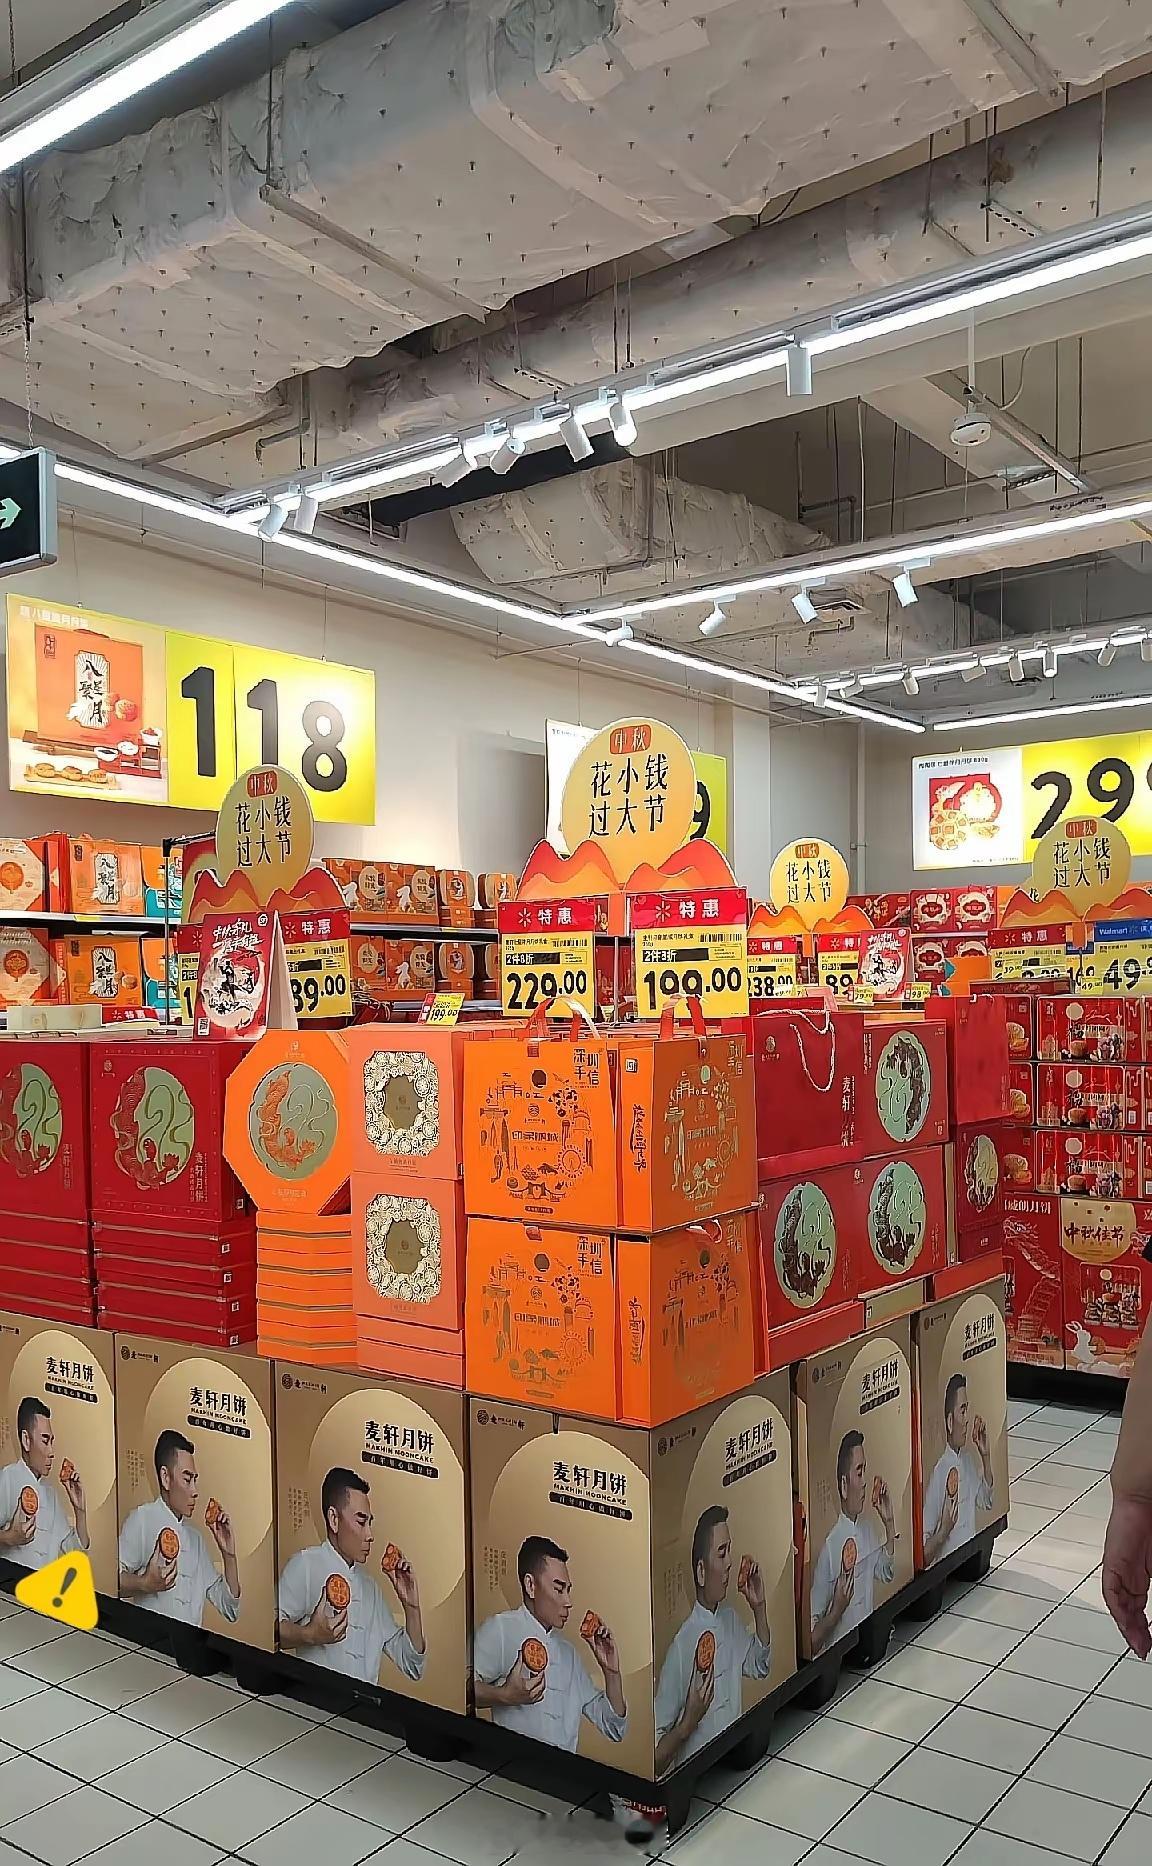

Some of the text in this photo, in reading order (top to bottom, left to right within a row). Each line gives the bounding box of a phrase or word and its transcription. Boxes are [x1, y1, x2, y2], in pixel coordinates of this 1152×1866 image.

[182, 666, 348, 792] 118
[614, 727, 648, 754] 中秋
[590, 754, 669, 798] 花小钱
[1031, 758, 1152, 839] 29
[235, 795, 291, 834] 花小钱
[589, 794, 667, 838] 过大节
[236, 830, 292, 867] 过大节
[1053, 837, 1111, 865] 花小钱
[786, 860, 831, 882] 花小钱
[1053, 861, 1111, 888] 过大节
[787, 882, 832, 903] 过大节
[538, 907, 572, 925] 特惠
[679, 899, 719, 919] 特惠
[302, 919, 331, 935] 特惠
[1021, 930, 1048, 942] 特惠
[1099, 927, 1128, 936] Walmart
[506, 953, 535, 965] 2件8折
[507, 970, 587, 1010] 229.00
[644, 967, 742, 1010] 199.00
[1064, 1222, 1125, 1249] 中秋佳节
[46, 1356, 95, 1383] 麦轩月饼
[861, 1358, 899, 1394] 麦轩月饼
[190, 1386, 247, 1417] 麦轩月饼
[365, 1420, 435, 1455] 麦轩月饼
[725, 1417, 774, 1463] 麦轩月饼
[394, 1448, 435, 1464] MOONCAKE
[553, 1461, 627, 1496] 麦轩月饼
[585, 1491, 627, 1506] MOONCAKE
